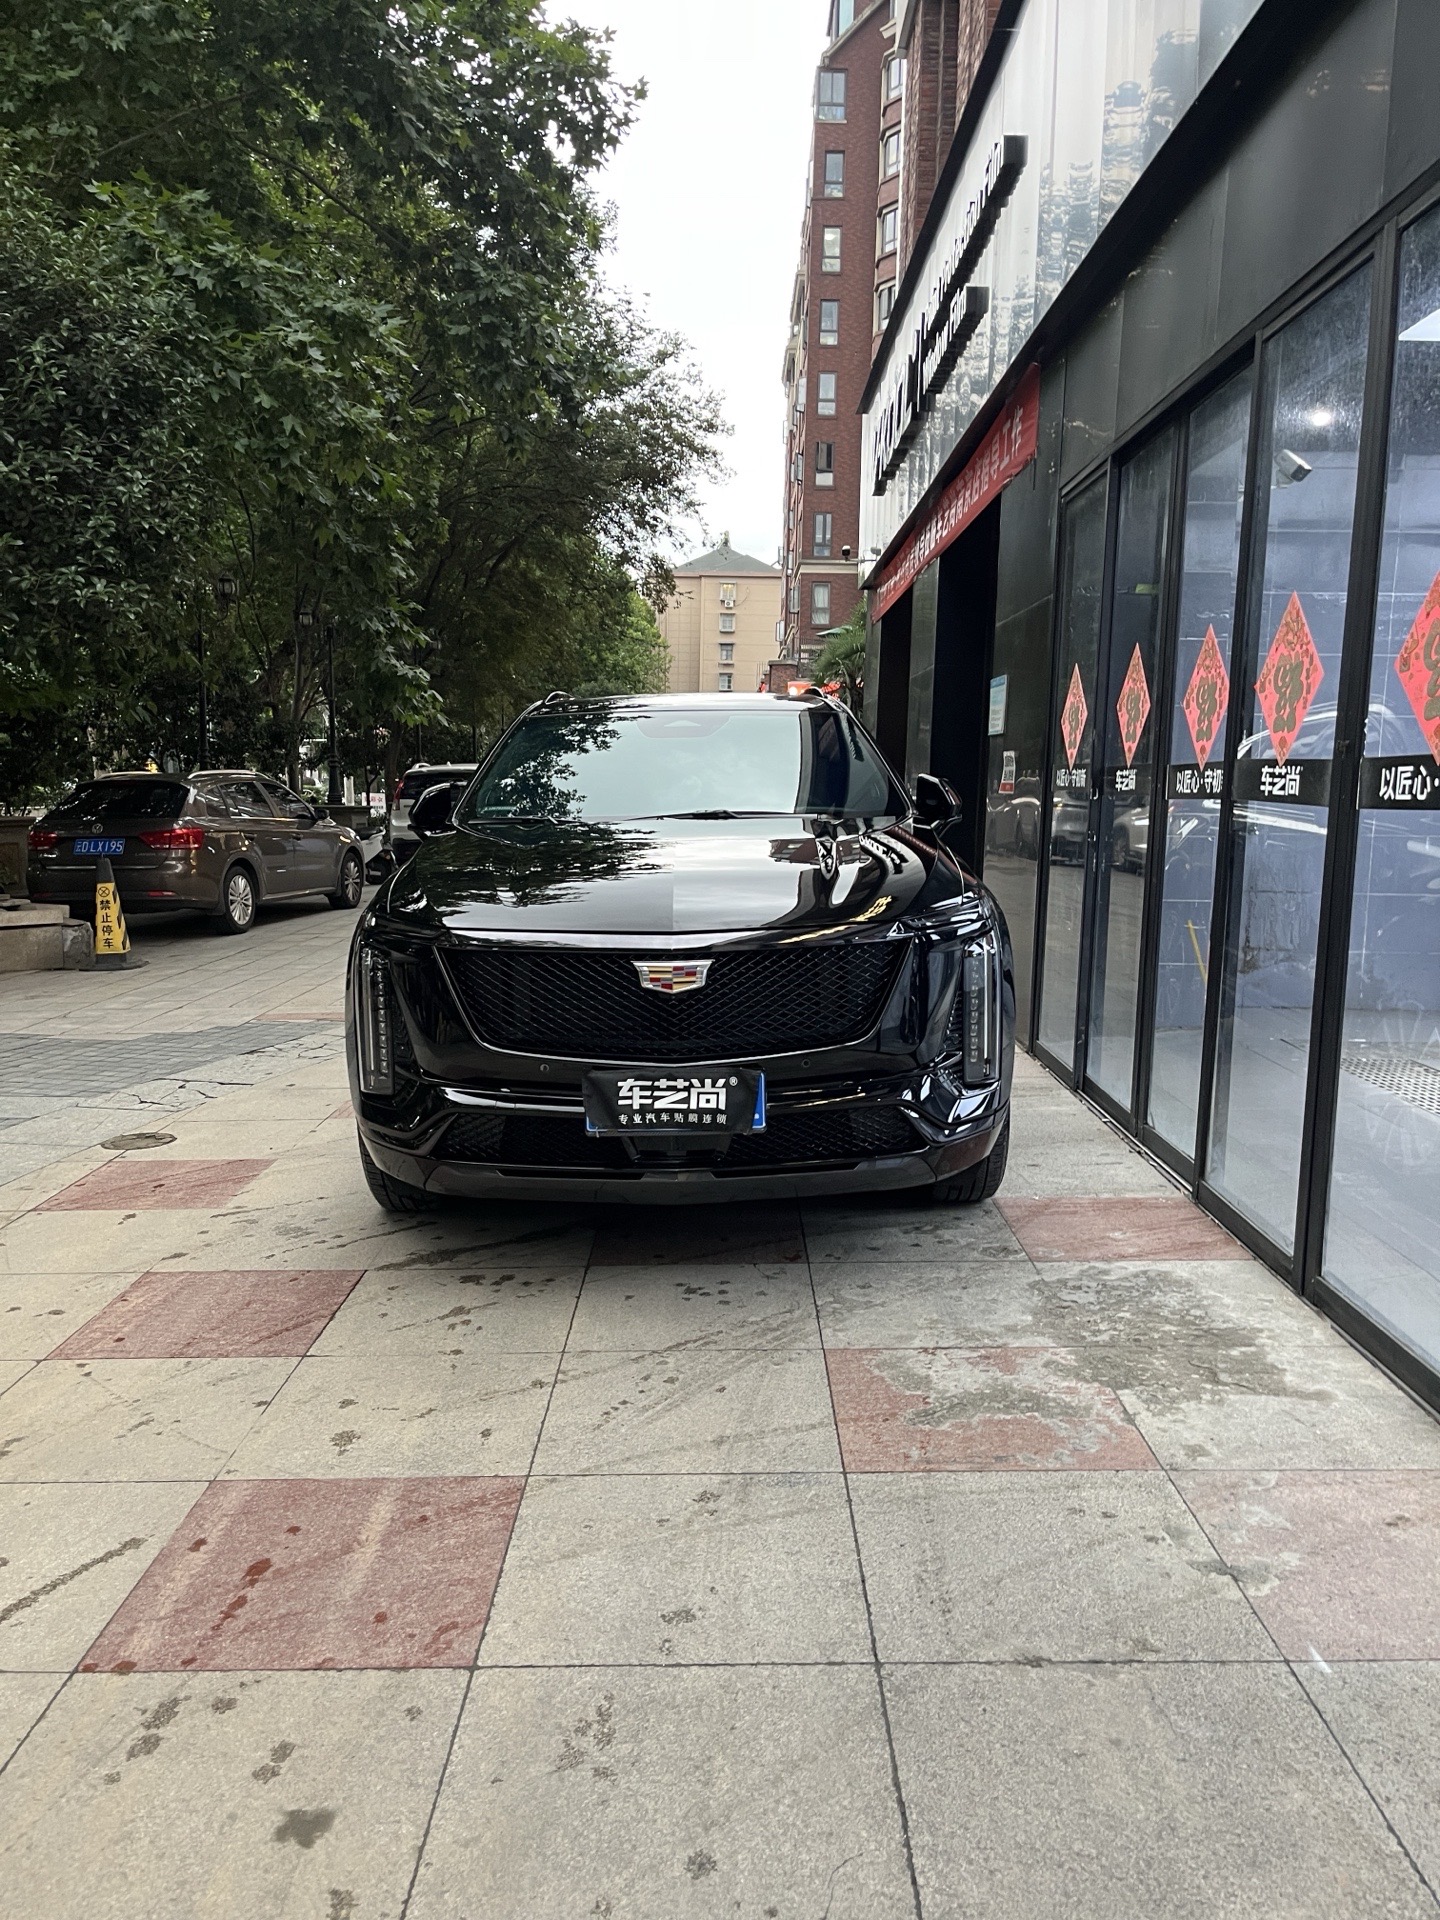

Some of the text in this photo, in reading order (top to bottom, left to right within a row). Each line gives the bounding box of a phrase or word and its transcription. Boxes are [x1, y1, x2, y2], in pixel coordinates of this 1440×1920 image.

[985, 136, 1004, 196] Film
[949, 286, 967, 342] Film
[1115, 769, 1137, 792] 车艺尚
[1175, 768, 1224, 794] 以匠心·守初
[1260, 765, 1302, 796] 车艺尚
[99, 899, 114, 949] 禁止停车
[618, 1112, 727, 1125] 专业汽车贴膜连锁
